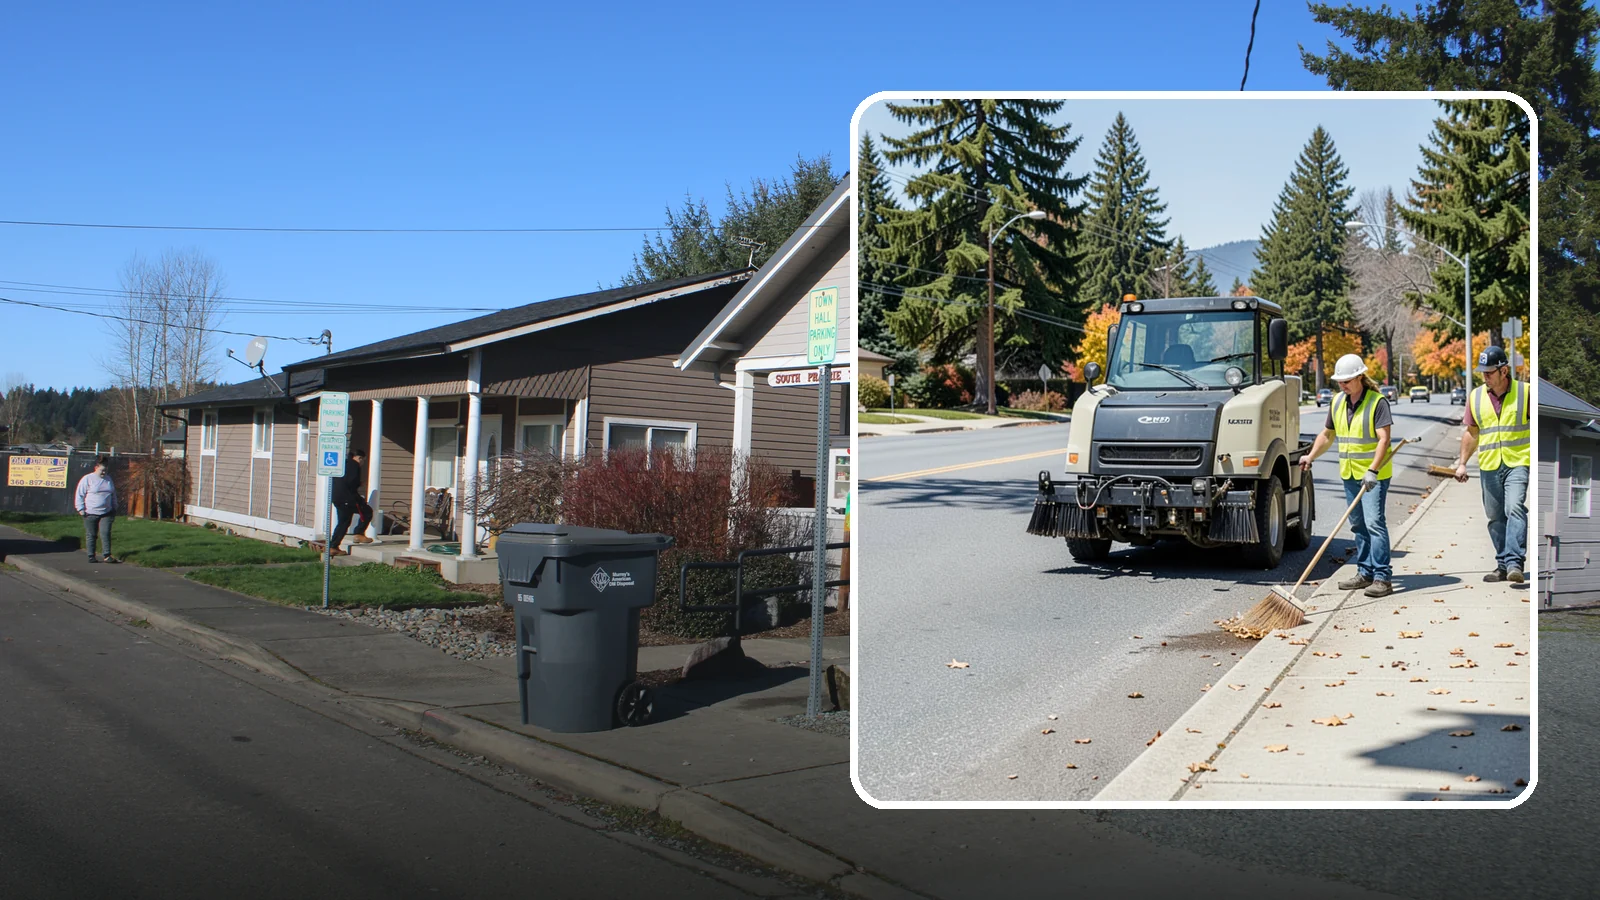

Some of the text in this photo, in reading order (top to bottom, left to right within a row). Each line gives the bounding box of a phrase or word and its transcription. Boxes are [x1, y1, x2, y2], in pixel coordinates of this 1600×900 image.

[815, 294, 833, 308] TOWN
[814, 311, 831, 324] HALL
[810, 326, 836, 340] PARKING
[813, 343, 831, 357] ONLY
[775, 374, 801, 384] SOUTH
